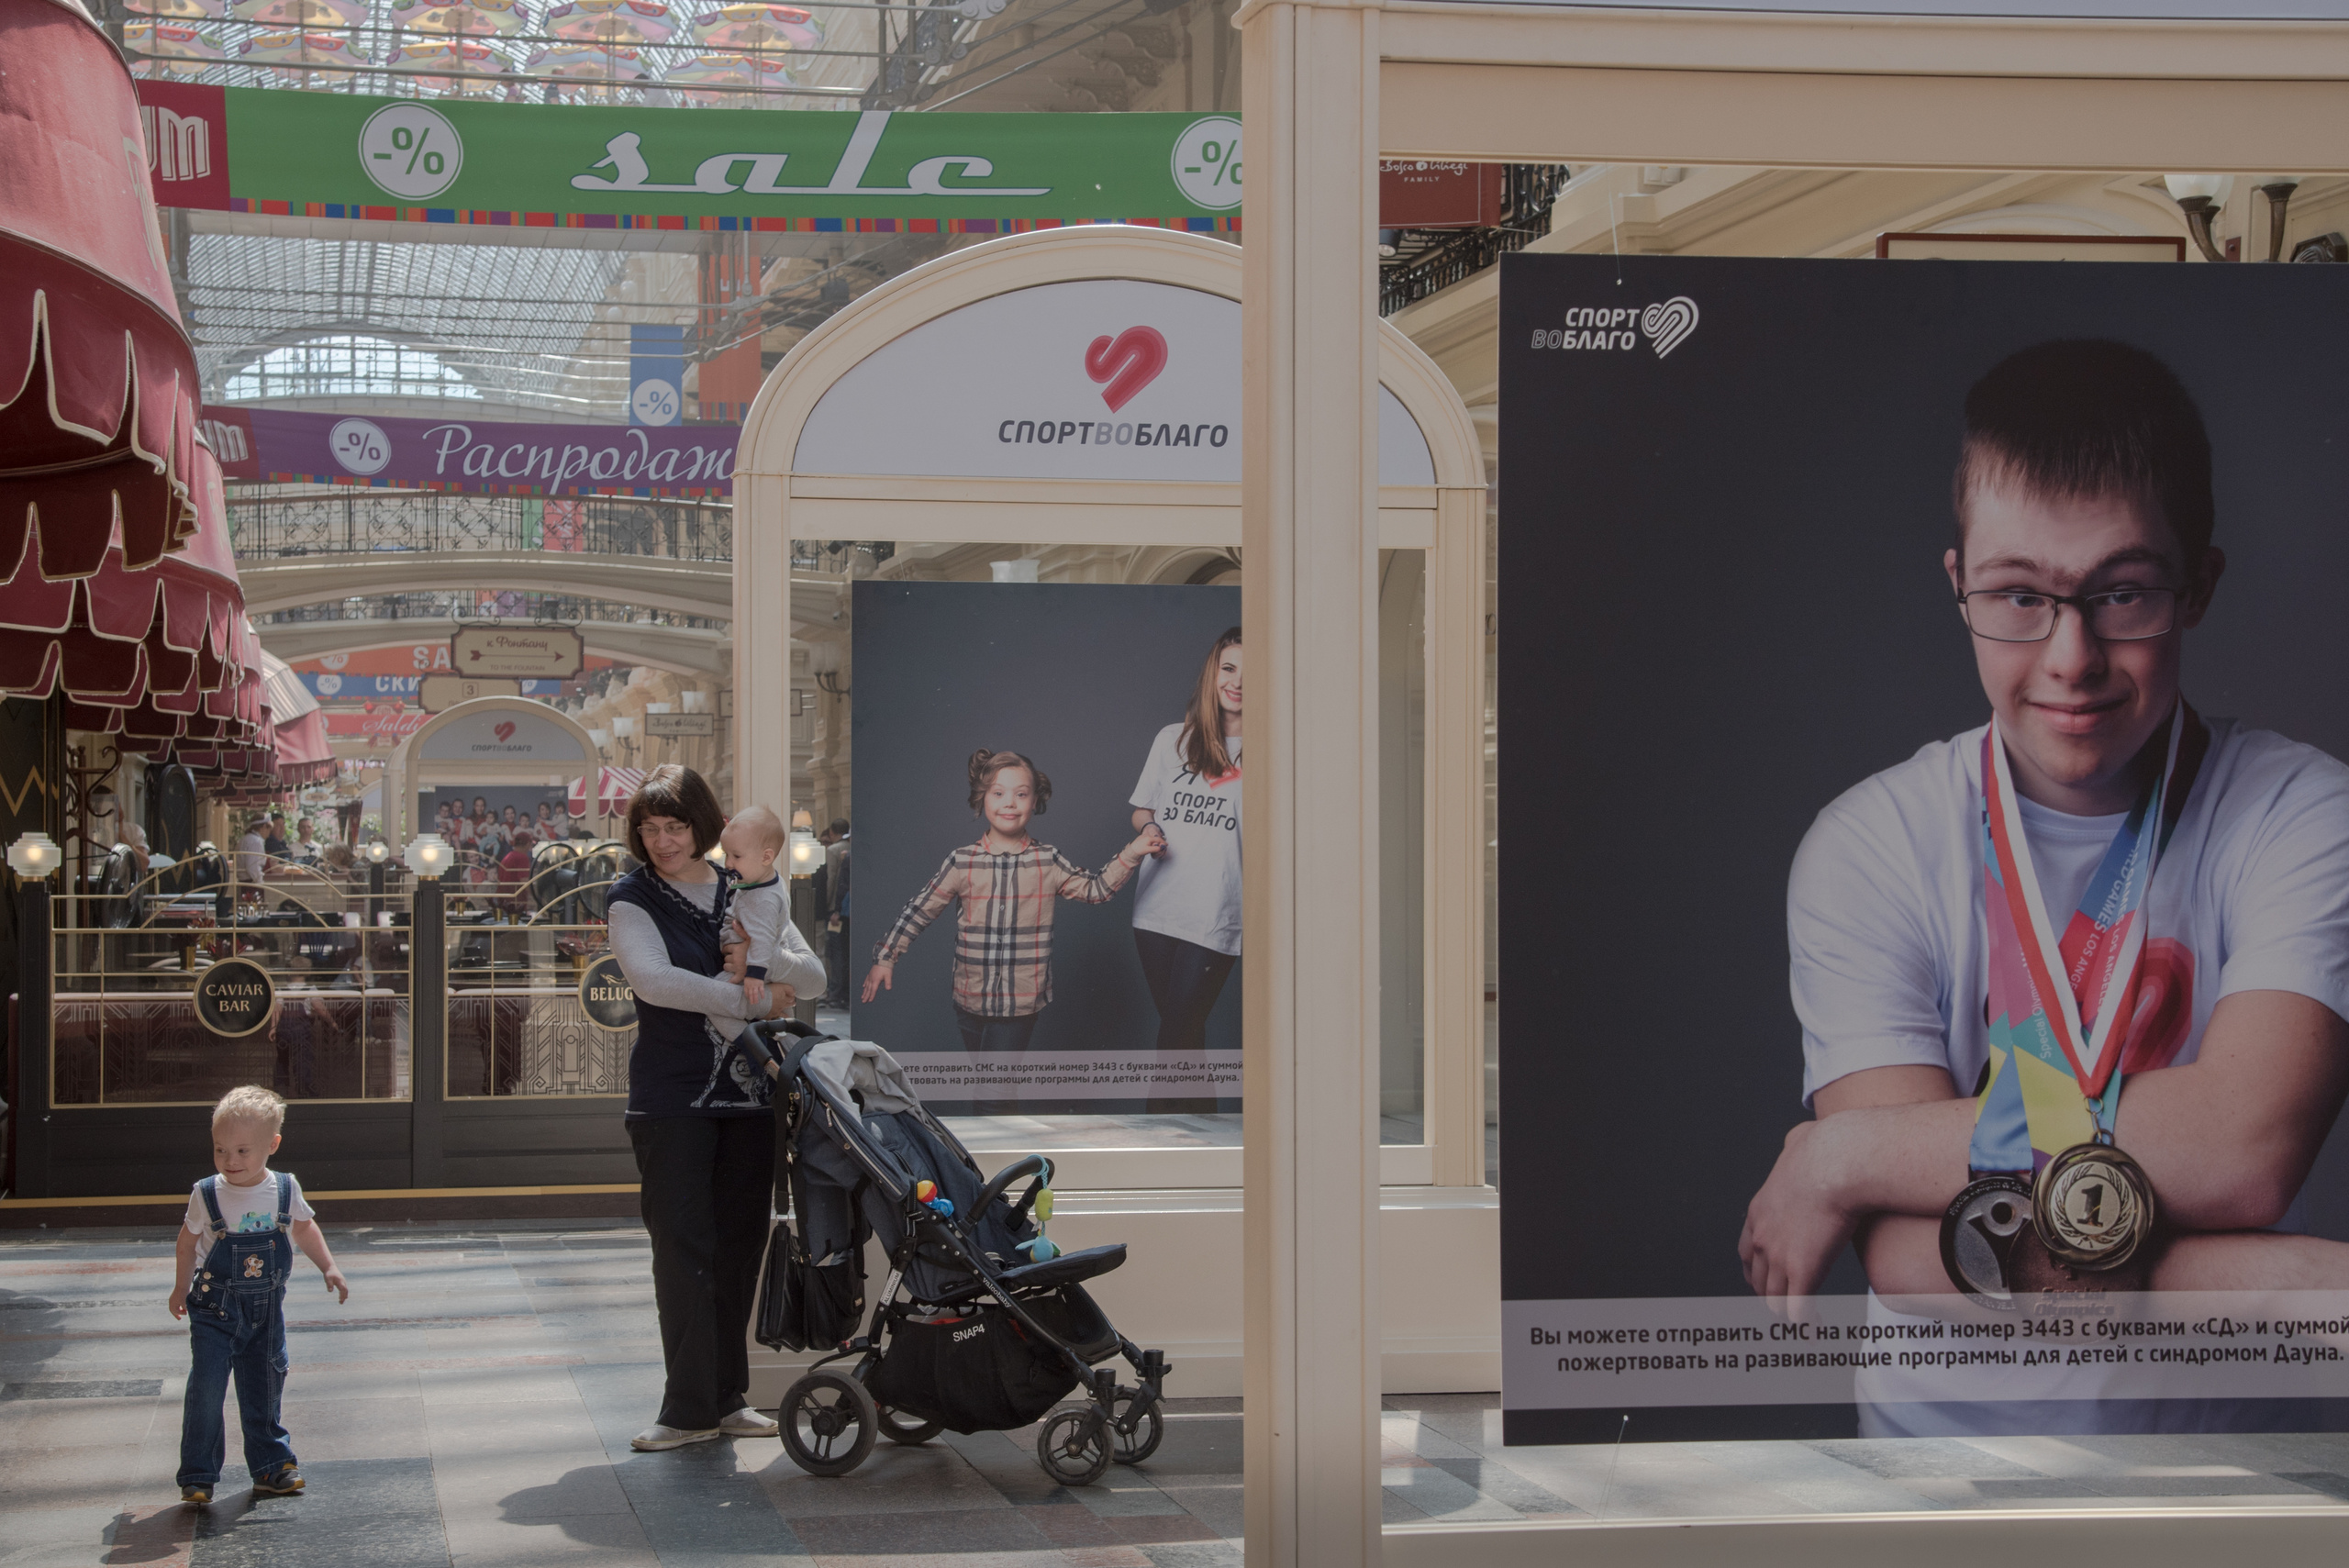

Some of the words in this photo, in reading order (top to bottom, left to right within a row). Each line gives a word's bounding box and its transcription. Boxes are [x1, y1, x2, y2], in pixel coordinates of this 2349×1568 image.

[570, 110, 1054, 196] sale
[1565, 307, 1641, 328] СПОРТ
[997, 419, 1230, 448] СПОРТВОБЛАГО
[495, 635, 549, 652] Фонтану
[466, 684, 474, 695] 3
[1174, 791, 1228, 811] СПОРТ
[1184, 809, 1237, 831] БЛАГО
[2094, 880, 2123, 934] GAMES
[2083, 933, 2100, 958] LOS
[2110, 927, 2121, 952] LOS
[206, 984, 263, 996] CAVIAR
[219, 1000, 250, 1012] BAR
[2035, 1018, 2052, 1060] Special
[922, 1064, 973, 1073] отправить
[975, 1063, 995, 1073] СМС
[1011, 1062, 1057, 1073] короткий
[1059, 1063, 1090, 1073] номер
[1092, 1062, 1117, 1071] 3443
[1127, 1062, 1168, 1073] буквами
[1170, 1061, 1197, 1072] «СД»
[1208, 1061, 1242, 1072] суммой
[964, 1076, 1032, 1085] развивающие
[1035, 1075, 1090, 1085] программы
[1093, 1075, 1110, 1084] для
[1112, 1073, 1141, 1084] детей
[1151, 1074, 1205, 1084] синдромом
[1207, 1073, 1240, 1084] Дауна.
[2076, 1184, 2104, 1228] 1
[884, 1273, 901, 1304] ALUMINIUM
[982, 1276, 1012, 1308] valcobaby
[952, 1323, 985, 1343] SNAP4
[1531, 1327, 1561, 1345] Вы
[1567, 1328, 1650, 1345] можете
[1656, 1327, 1764, 1347] отправить
[1769, 1323, 1810, 1341] СМС
[1817, 1325, 1840, 1340] на
[1847, 1320, 1944, 1343] короткий
[1951, 1323, 2016, 1341] номер
[2022, 1319, 2075, 1338] 3443
[2081, 1322, 2090, 1337] с
[2097, 1318, 2186, 1340] буквами
[2191, 1318, 2250, 1338] «СД»
[2256, 1321, 2267, 1335] и
[2275, 1316, 2349, 1339] суммой
[1558, 1354, 1709, 1375] пожертвовать
[1715, 1353, 1739, 1369] на
[1745, 1351, 1892, 1373] развивающие
[1899, 1350, 2017, 1370] программы
[2023, 1349, 2061, 1367] для
[2066, 1345, 2128, 1366] детей
[2134, 1348, 2143, 1362] с
[2150, 1346, 2267, 1366] синдромом
[2273, 1343, 2344, 1366] Дауна.
